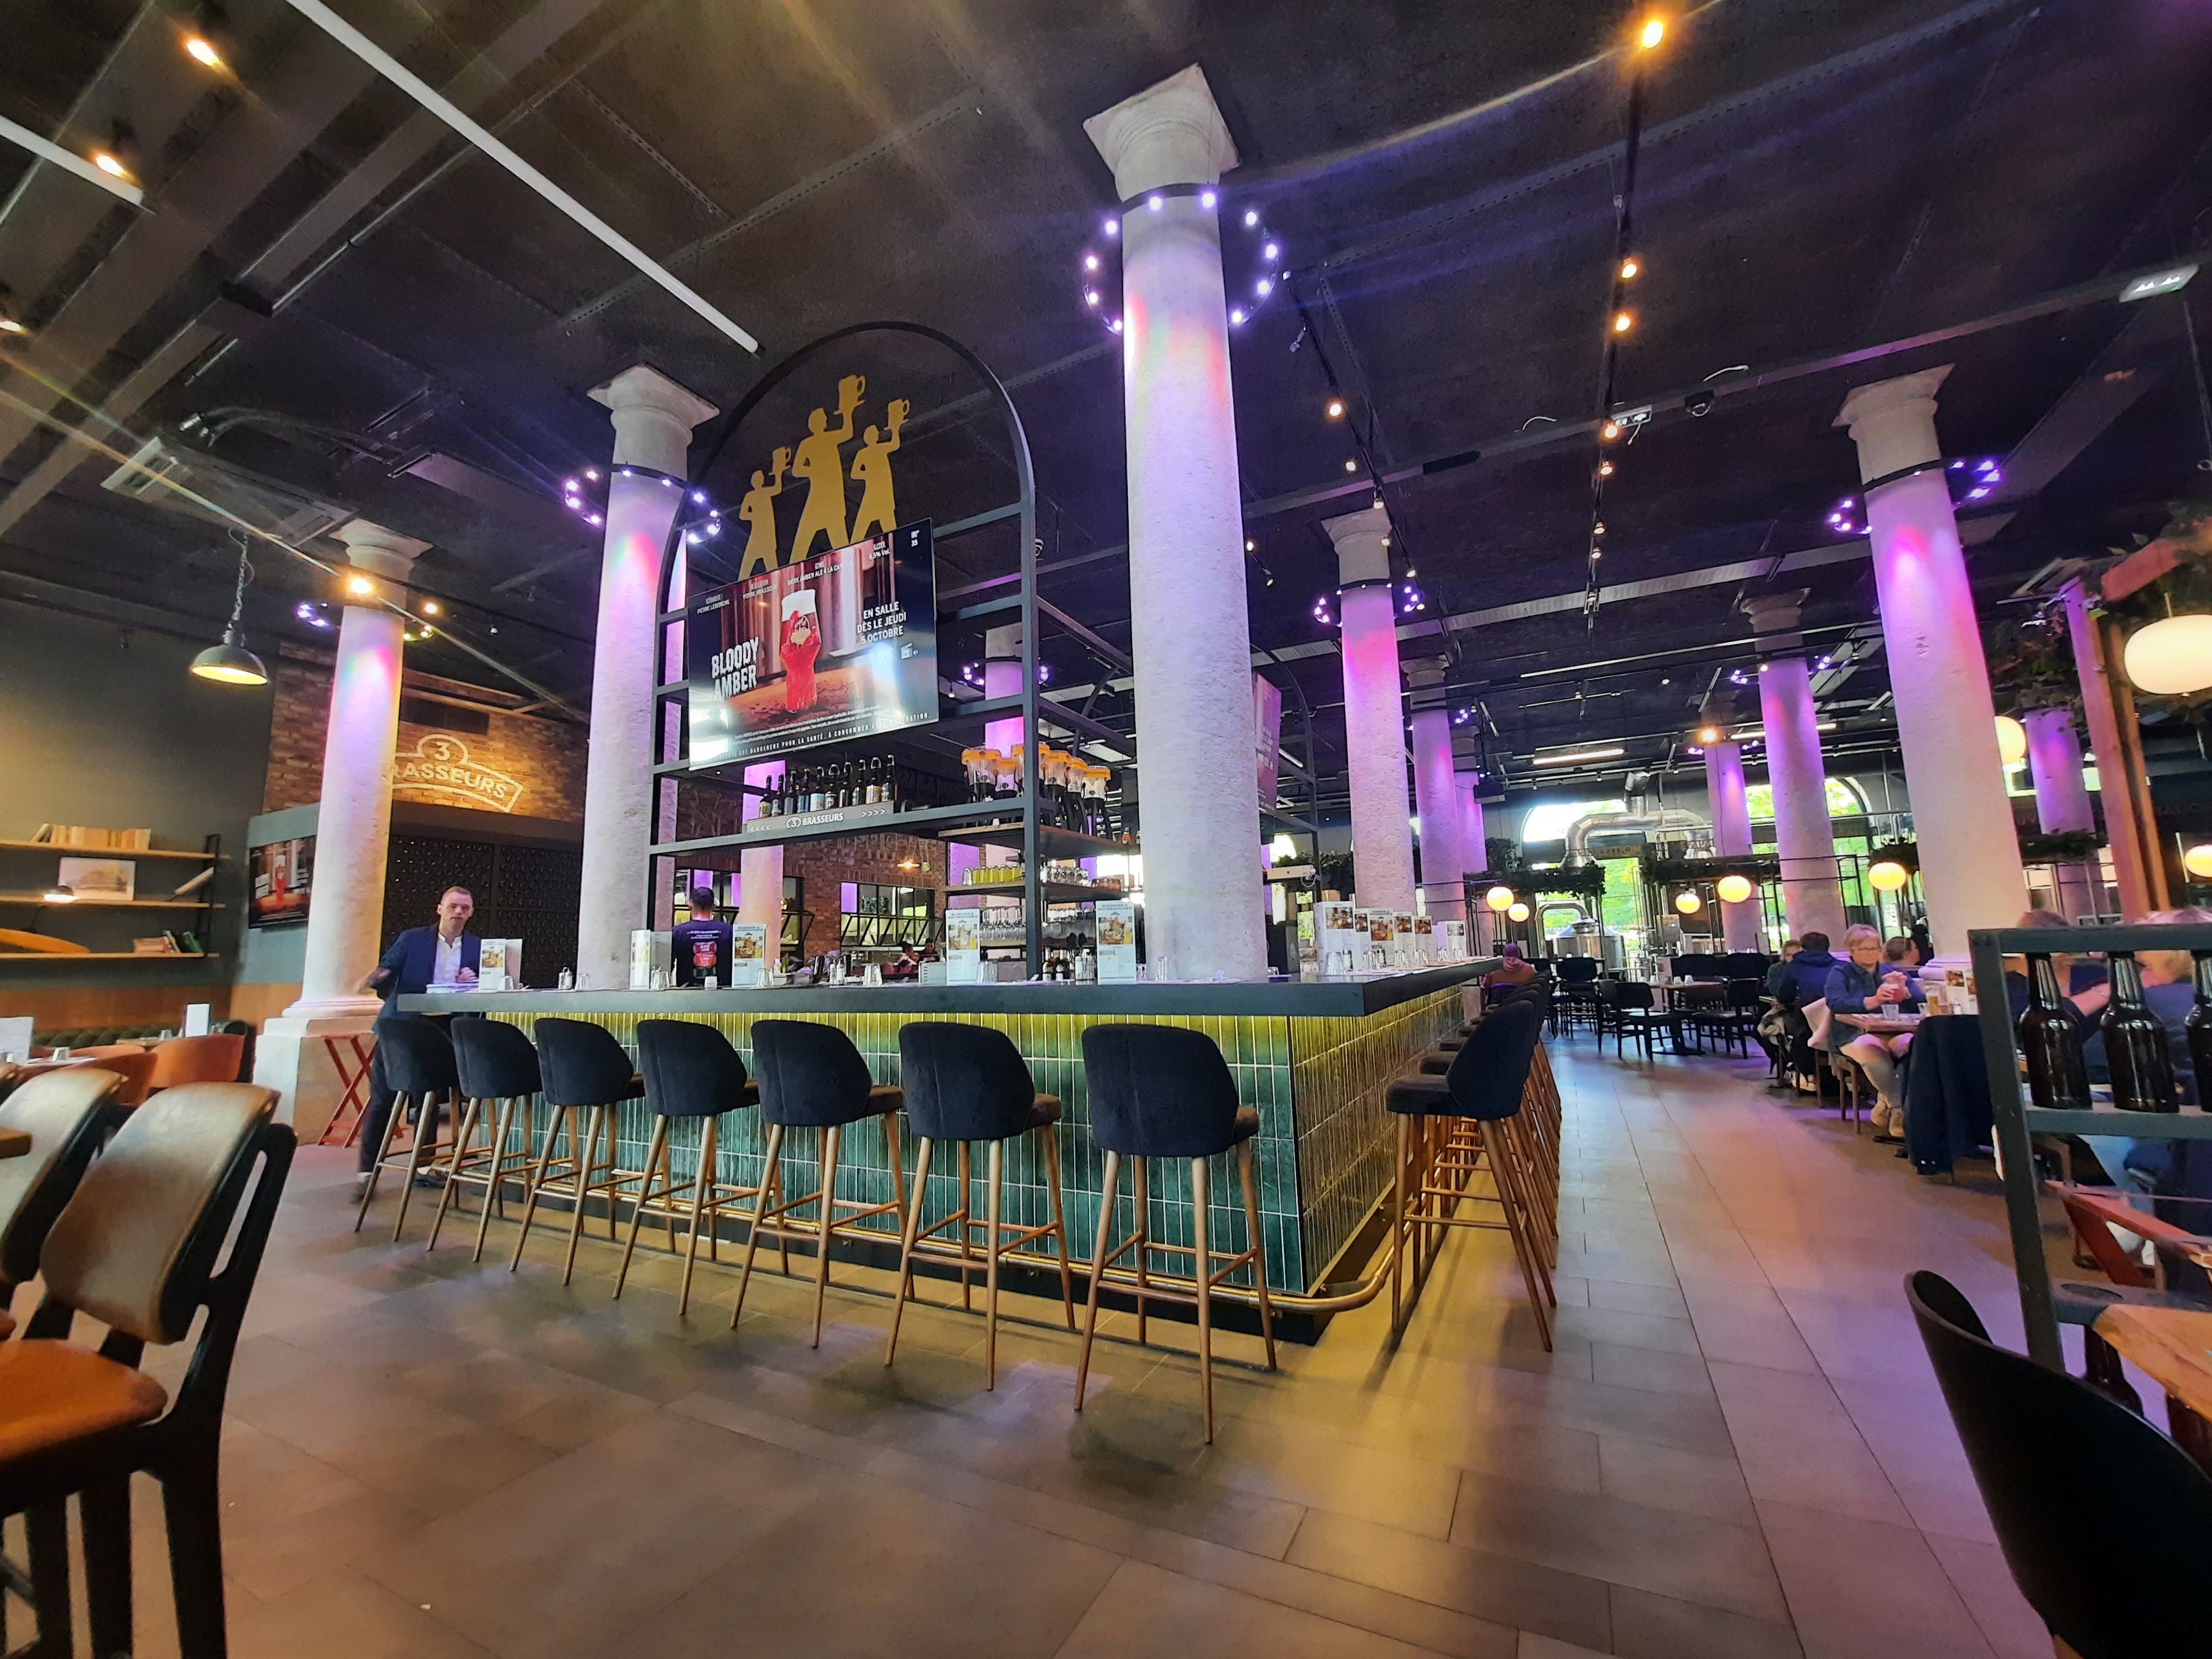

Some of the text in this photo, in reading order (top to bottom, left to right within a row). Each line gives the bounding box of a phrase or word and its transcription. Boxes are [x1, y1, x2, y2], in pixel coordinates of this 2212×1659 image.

[863, 601, 899, 619] EN SALLE
[857, 612, 906, 634] DÈS LE JEUDI
[860, 625, 904, 645] 5 OCTOBRE
[711, 636, 759, 679] BLOODY
[712, 664, 757, 703] AMBER
[433, 741, 451, 761] 3
[781, 739, 795, 748] POUR
[389, 761, 507, 799] RASSEURS
[802, 812, 844, 826] BRASSEURS
